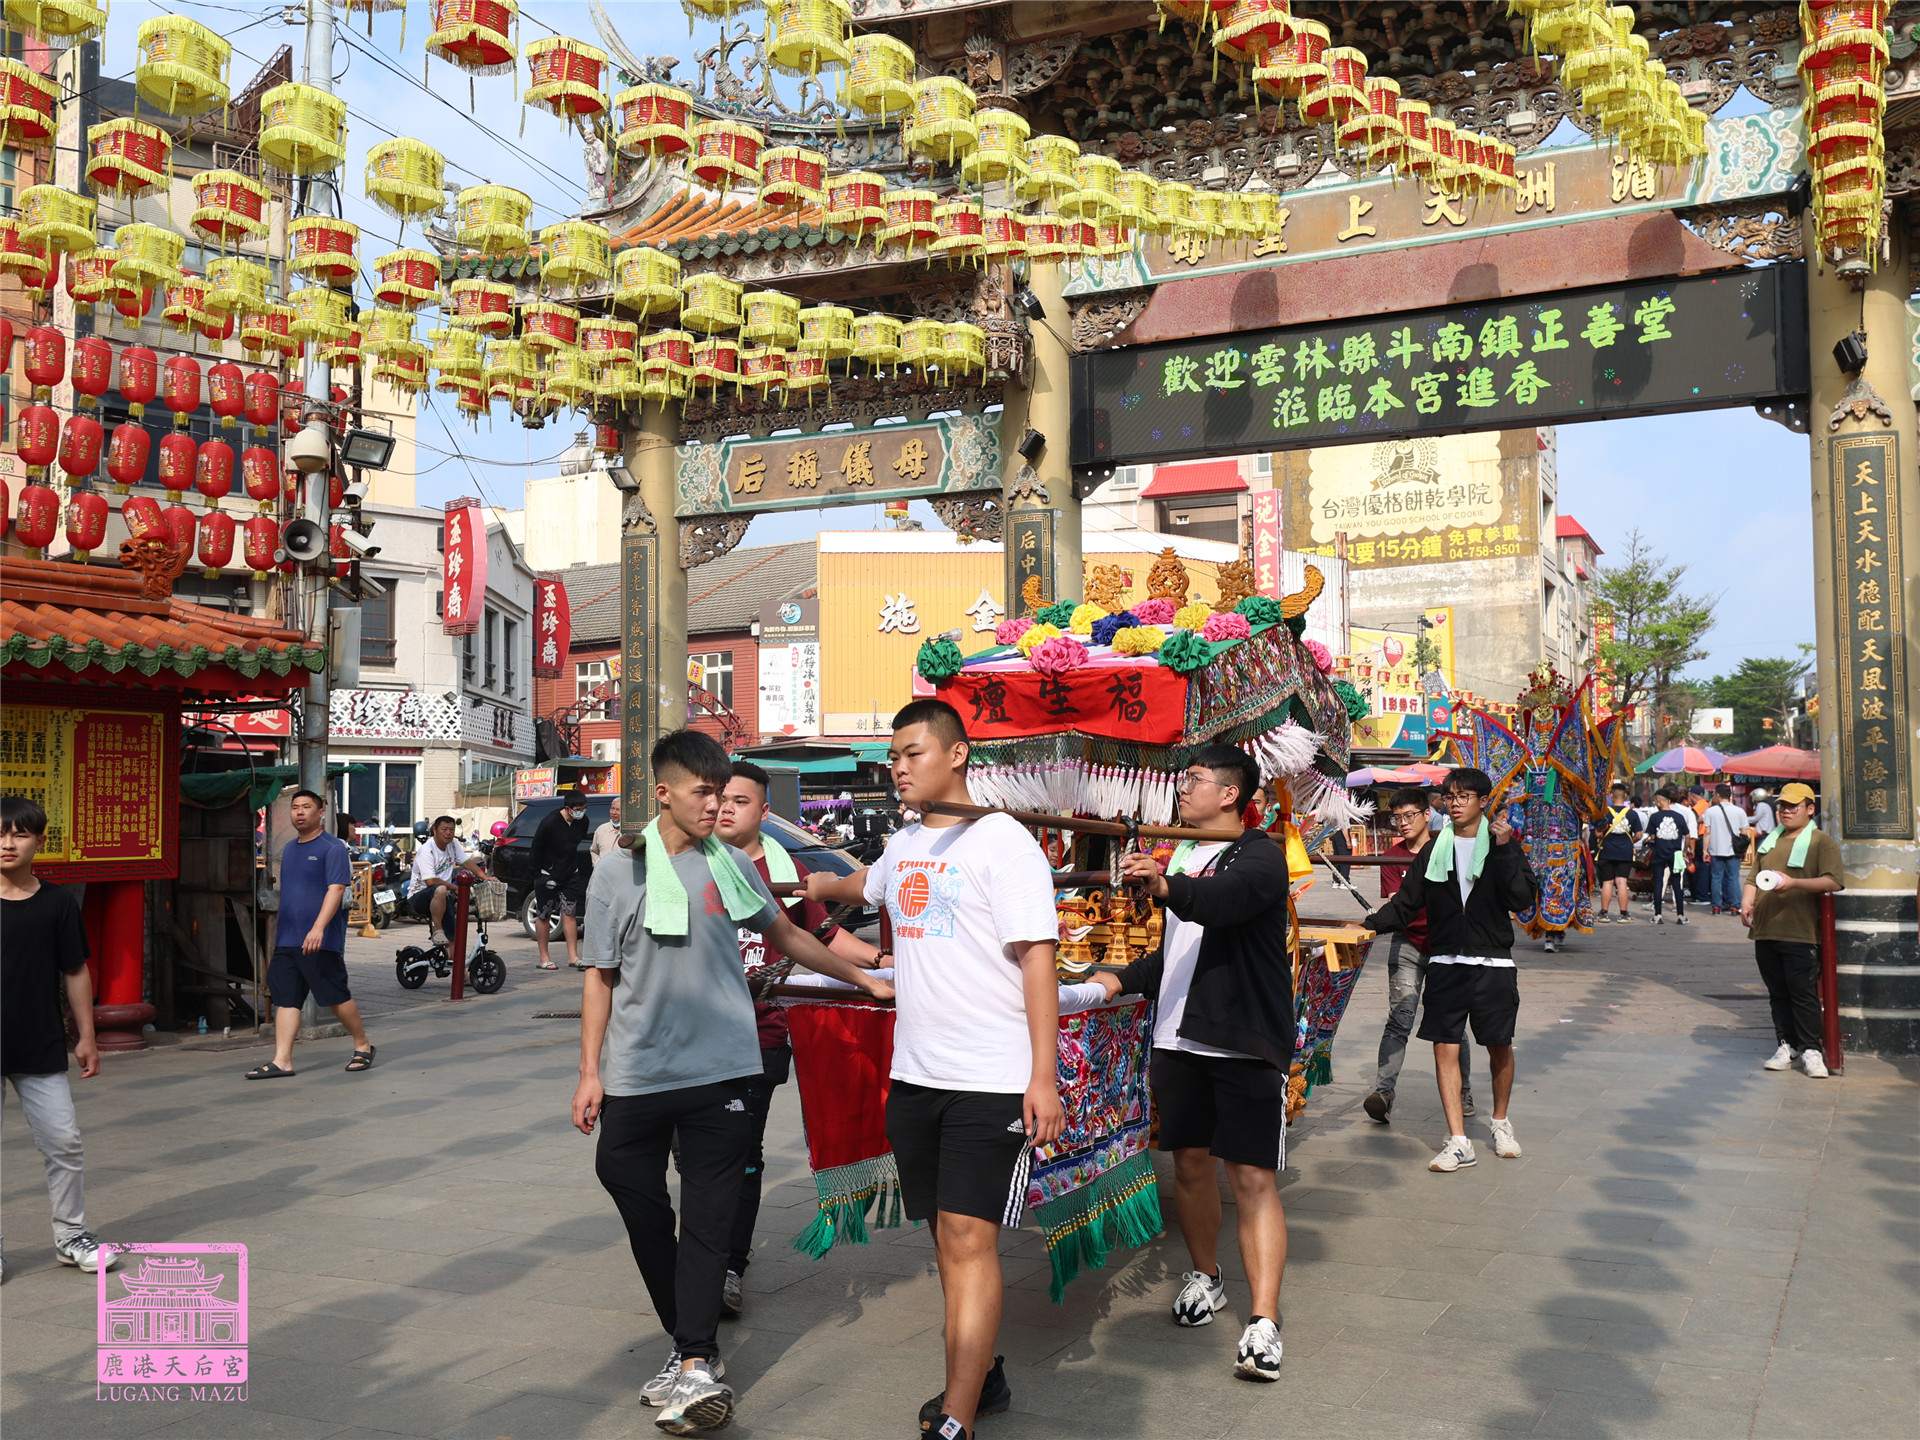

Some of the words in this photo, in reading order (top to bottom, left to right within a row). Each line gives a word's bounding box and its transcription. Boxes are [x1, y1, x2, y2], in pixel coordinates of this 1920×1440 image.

[1163, 296, 1676, 396] 歡迎雲林縣斗南鎮正善堂
[1273, 360, 1553, 428] 蒞臨本宮進香
[734, 438, 929, 494] 母儀稱后
[1321, 483, 1493, 519] 台灣優格餅乾學院
[1334, 521, 1363, 531] TAIWAN
[1365, 520, 1381, 528] YOU
[1383, 517, 1408, 527] GOOD
[1409, 513, 1441, 524] SCHOOL
[1443, 512, 1452, 520] OF
[1454, 509, 1485, 519] COOKIE
[446, 514, 464, 619] 玉珍齋
[1255, 495, 1278, 600] 施金玉
[1449, 525, 1519, 547] 免費參觀
[1449, 542, 1520, 560] 04-758-9501
[541, 583, 560, 668] 玉珍齋
[1850, 459, 1889, 815] 天上天水德配天風波平海國
[968, 672, 1147, 725] 福生壇
